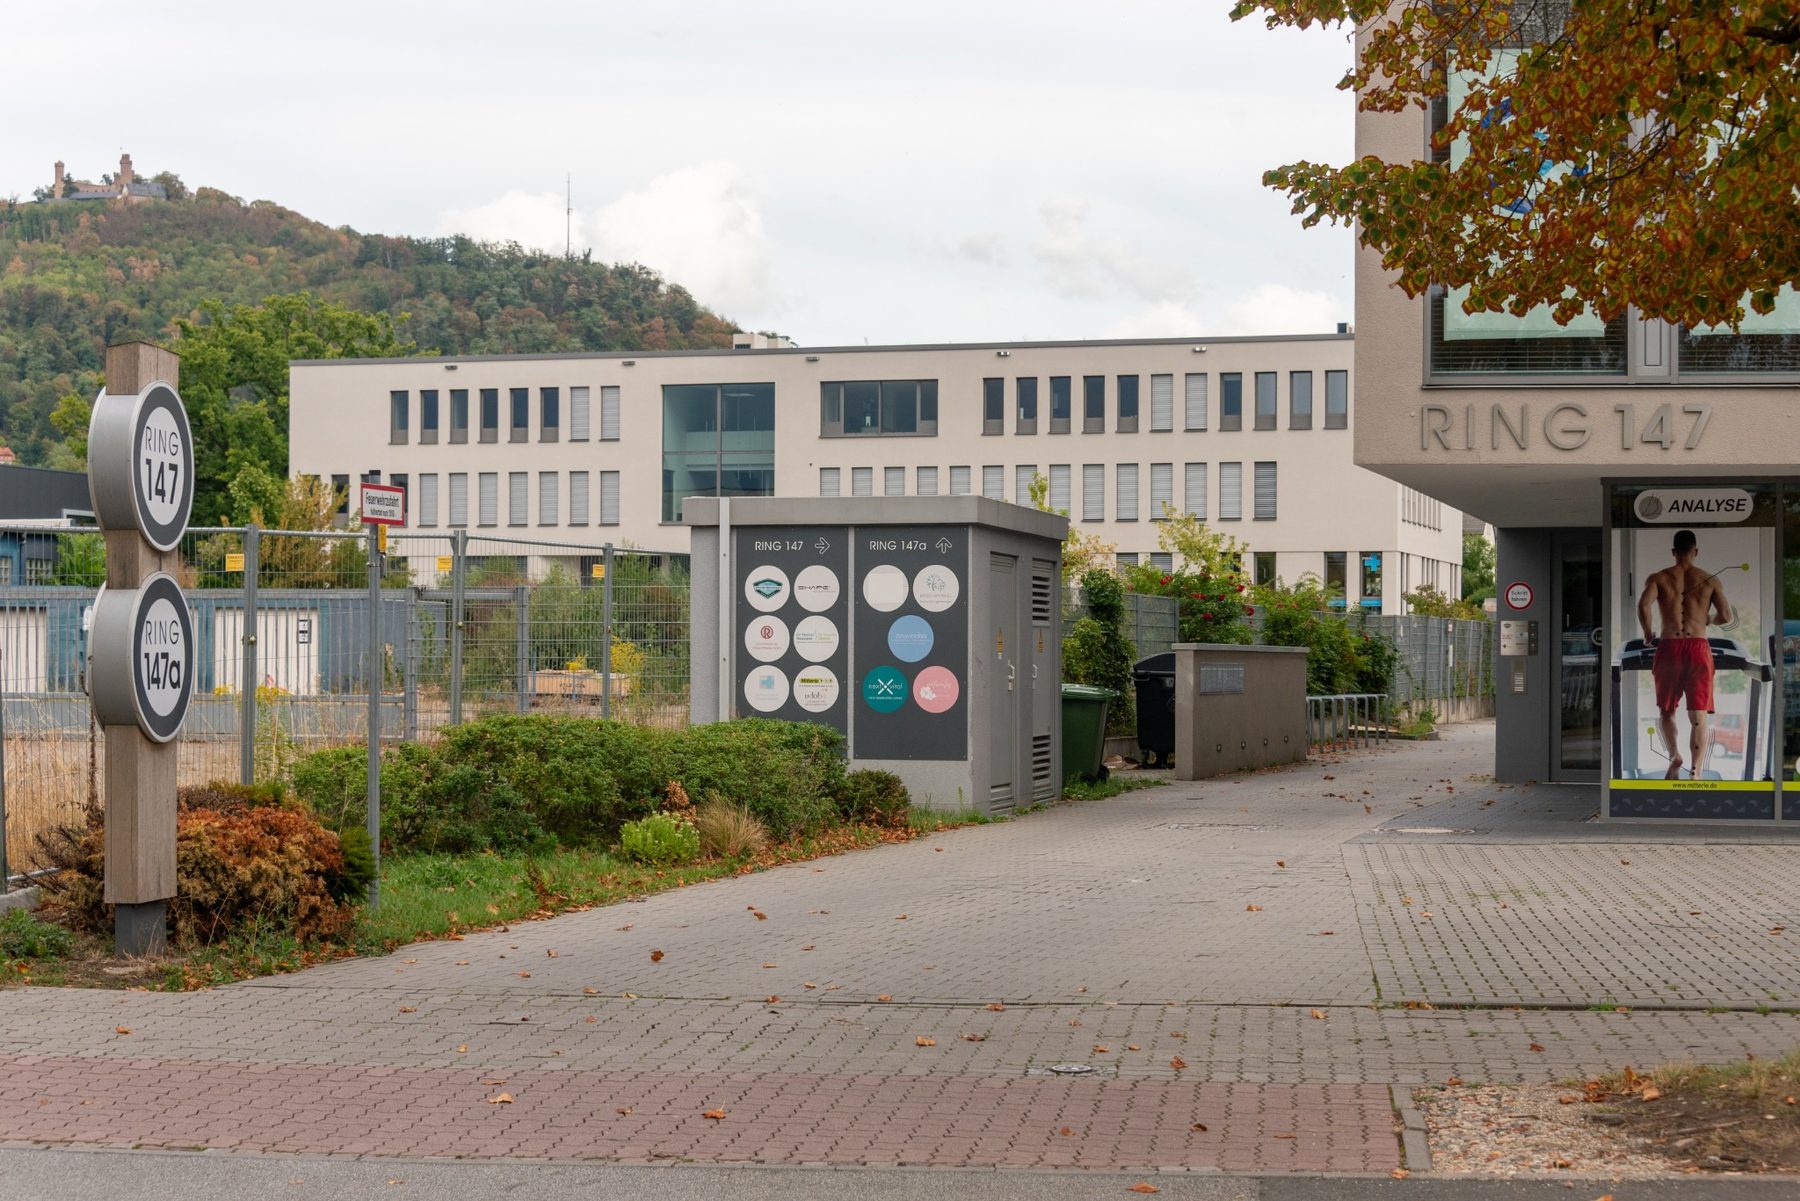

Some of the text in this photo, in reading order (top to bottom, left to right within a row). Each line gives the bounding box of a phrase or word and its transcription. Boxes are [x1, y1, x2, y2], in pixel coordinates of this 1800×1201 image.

[1421, 403, 1713, 450] RING 147
[145, 426, 179, 456] RING
[145, 458, 178, 505] 147
[1668, 498, 1748, 513] ANALYSE
[755, 541, 804, 551] RING 147
[869, 540, 927, 551] RING 147a
[145, 620, 179, 645] RING
[144, 652, 181, 690] 147a
